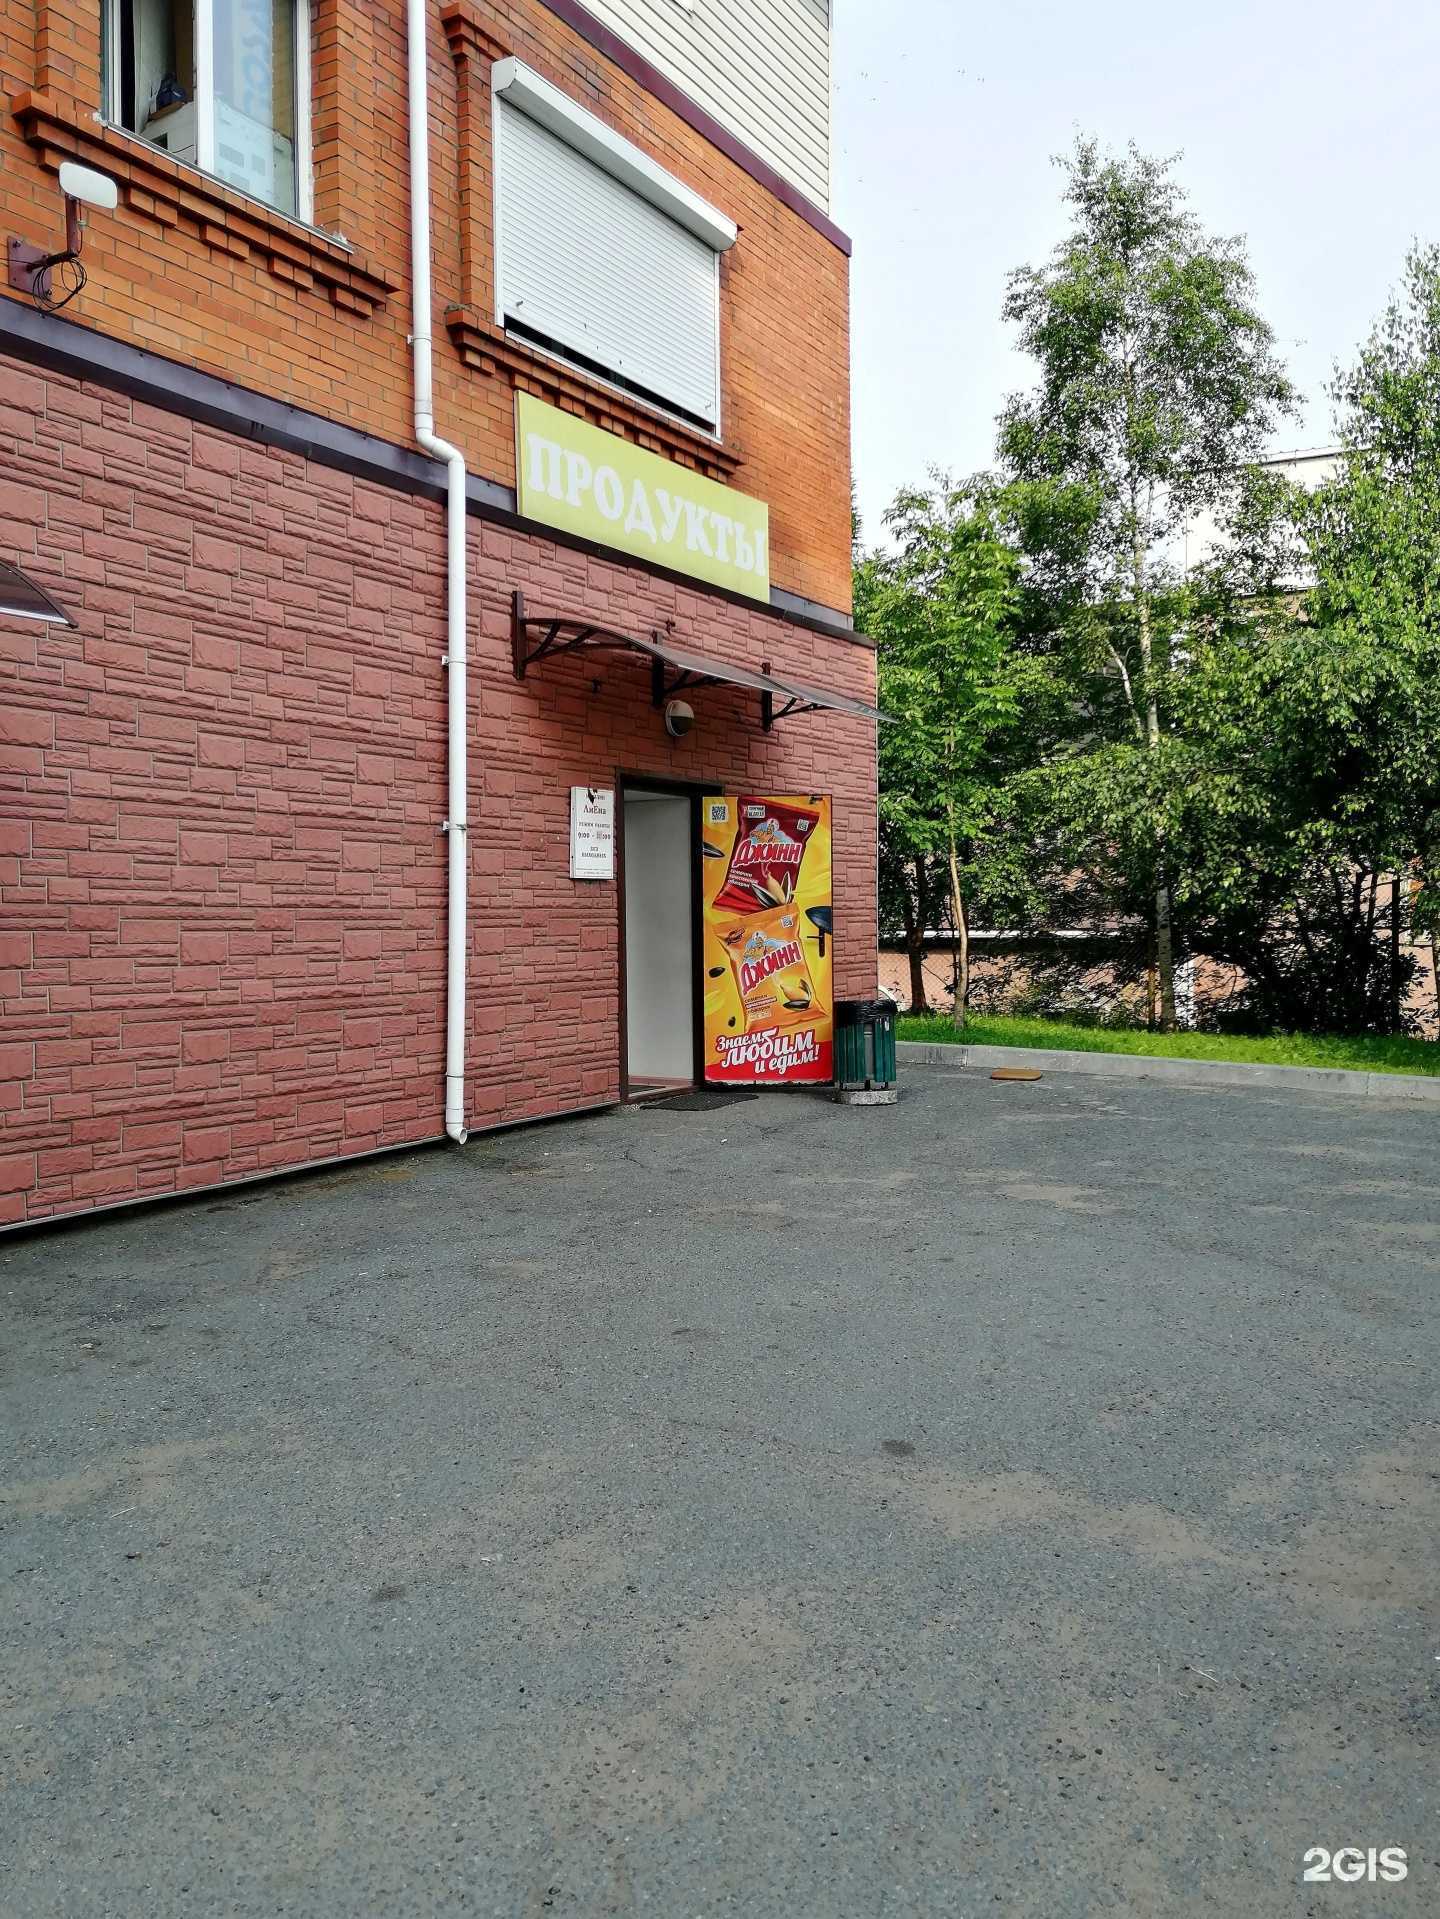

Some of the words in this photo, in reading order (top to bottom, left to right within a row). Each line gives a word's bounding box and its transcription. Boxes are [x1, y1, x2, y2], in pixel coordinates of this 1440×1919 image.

[527, 432, 767, 577] ПРОДУКТЫ
[755, 1059, 766, 1073] и
[768, 1044, 820, 1074] едим!
